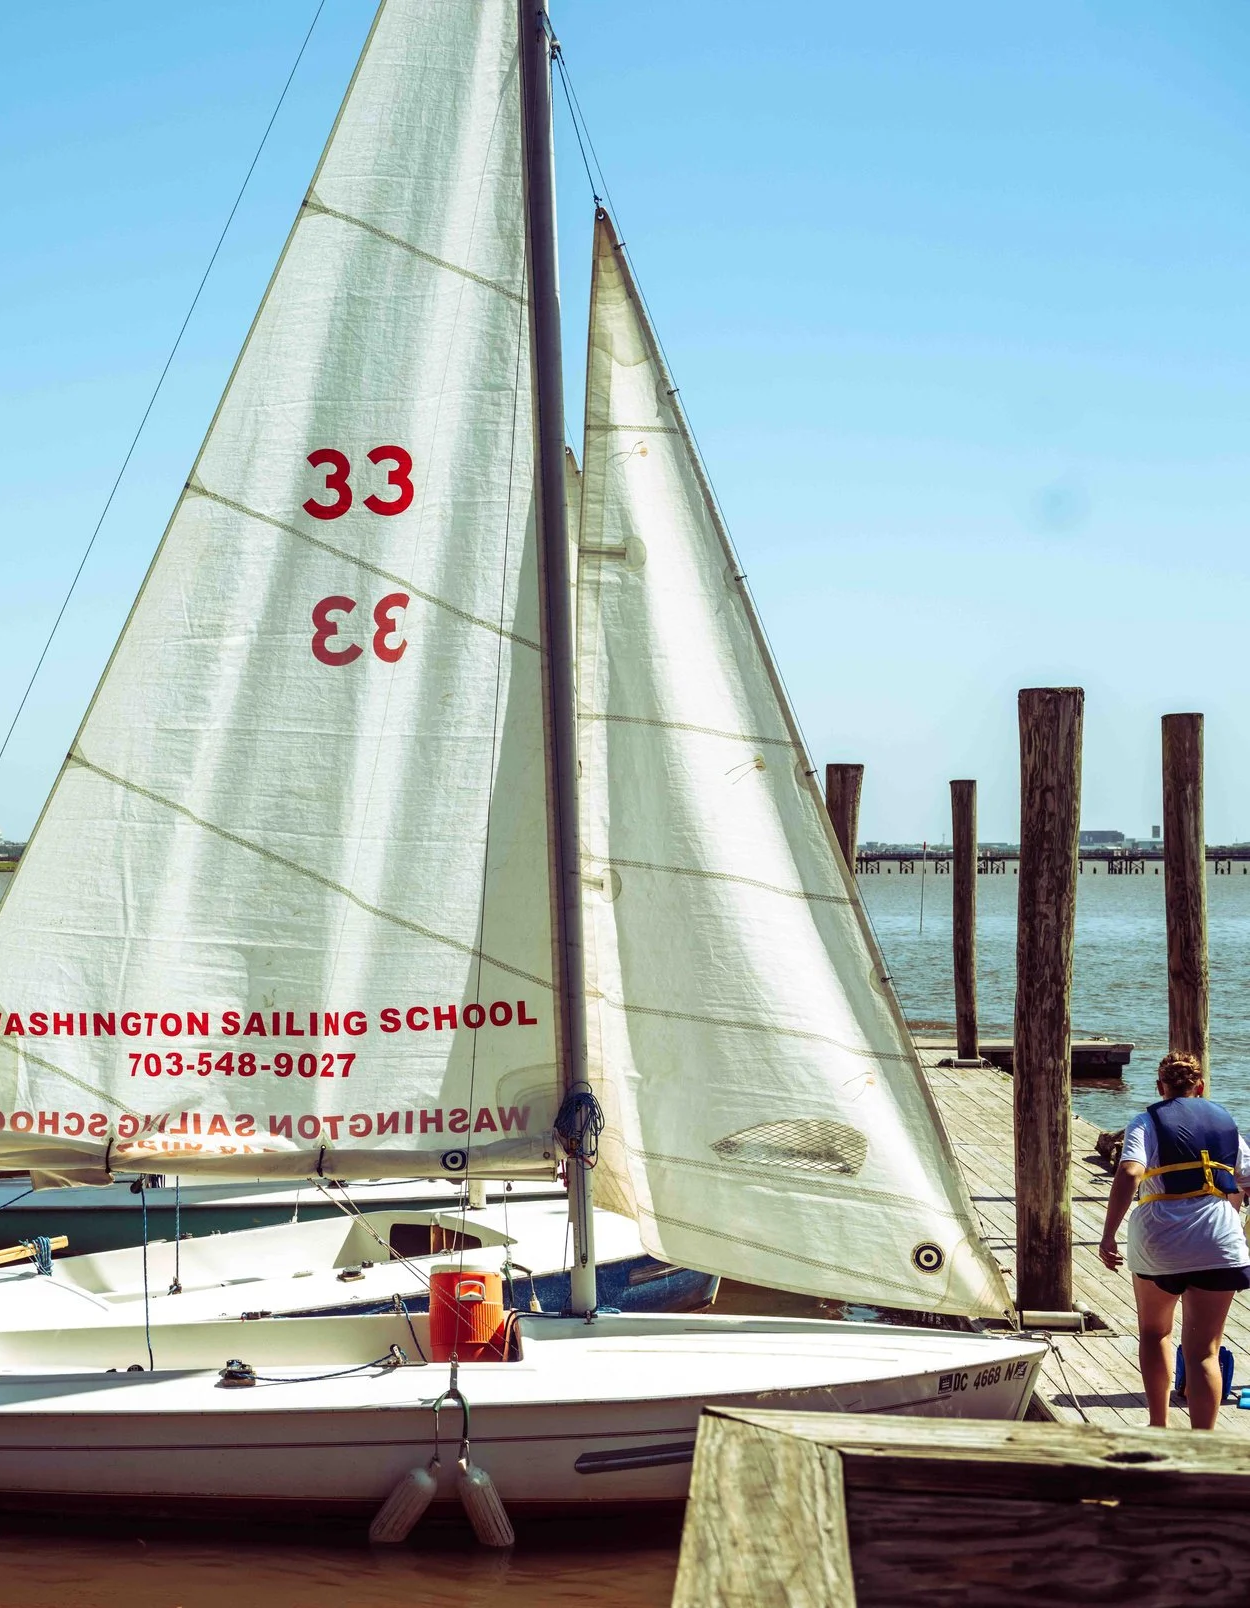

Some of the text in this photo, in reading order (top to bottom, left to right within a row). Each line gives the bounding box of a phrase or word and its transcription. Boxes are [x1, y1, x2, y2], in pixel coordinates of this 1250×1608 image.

[302, 445, 414, 520] 33
[221, 1011, 368, 1036] SAILING
[379, 1000, 538, 1033] SCHOOL
[128, 1052, 357, 1078] 703-548-9027
[953, 1373, 968, 1392] DC
[973, 1366, 1002, 1390] 4668
